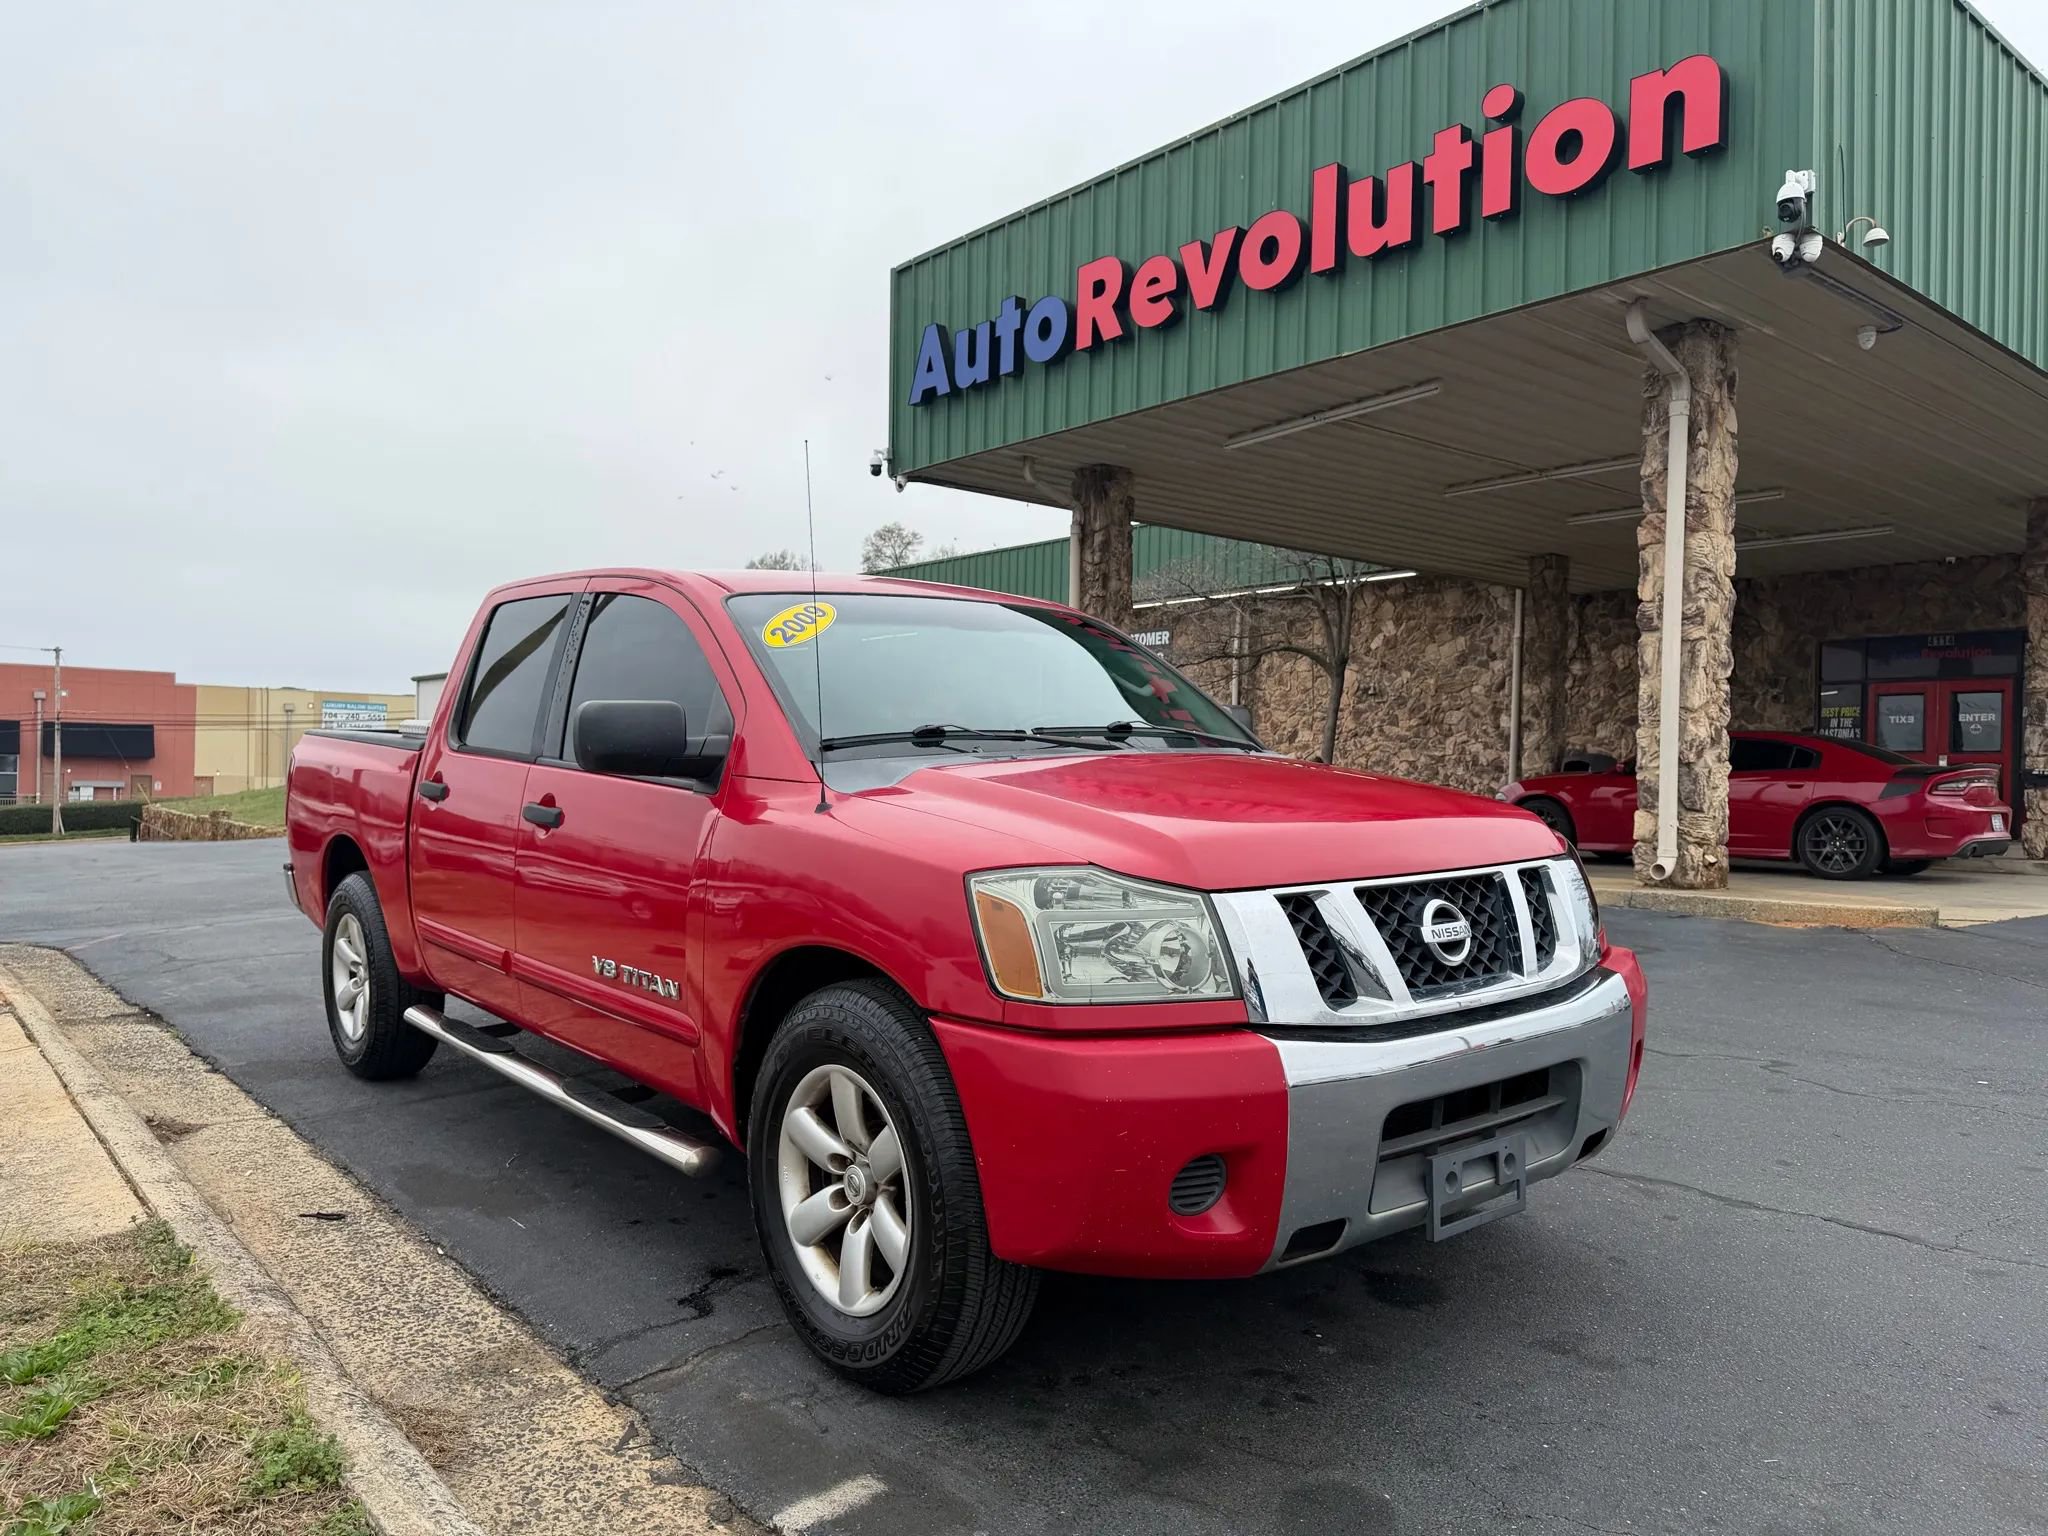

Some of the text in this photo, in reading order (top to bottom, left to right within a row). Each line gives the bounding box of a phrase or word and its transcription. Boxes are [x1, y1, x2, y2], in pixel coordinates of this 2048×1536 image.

[1821, 706, 1860, 717] BEST PRICE
[1830, 718, 1853, 728] IN THE
[1959, 713, 1996, 722] ENTER
[1432, 925, 1470, 940] NISSAN
[592, 955, 680, 1001] V8 TITAN
